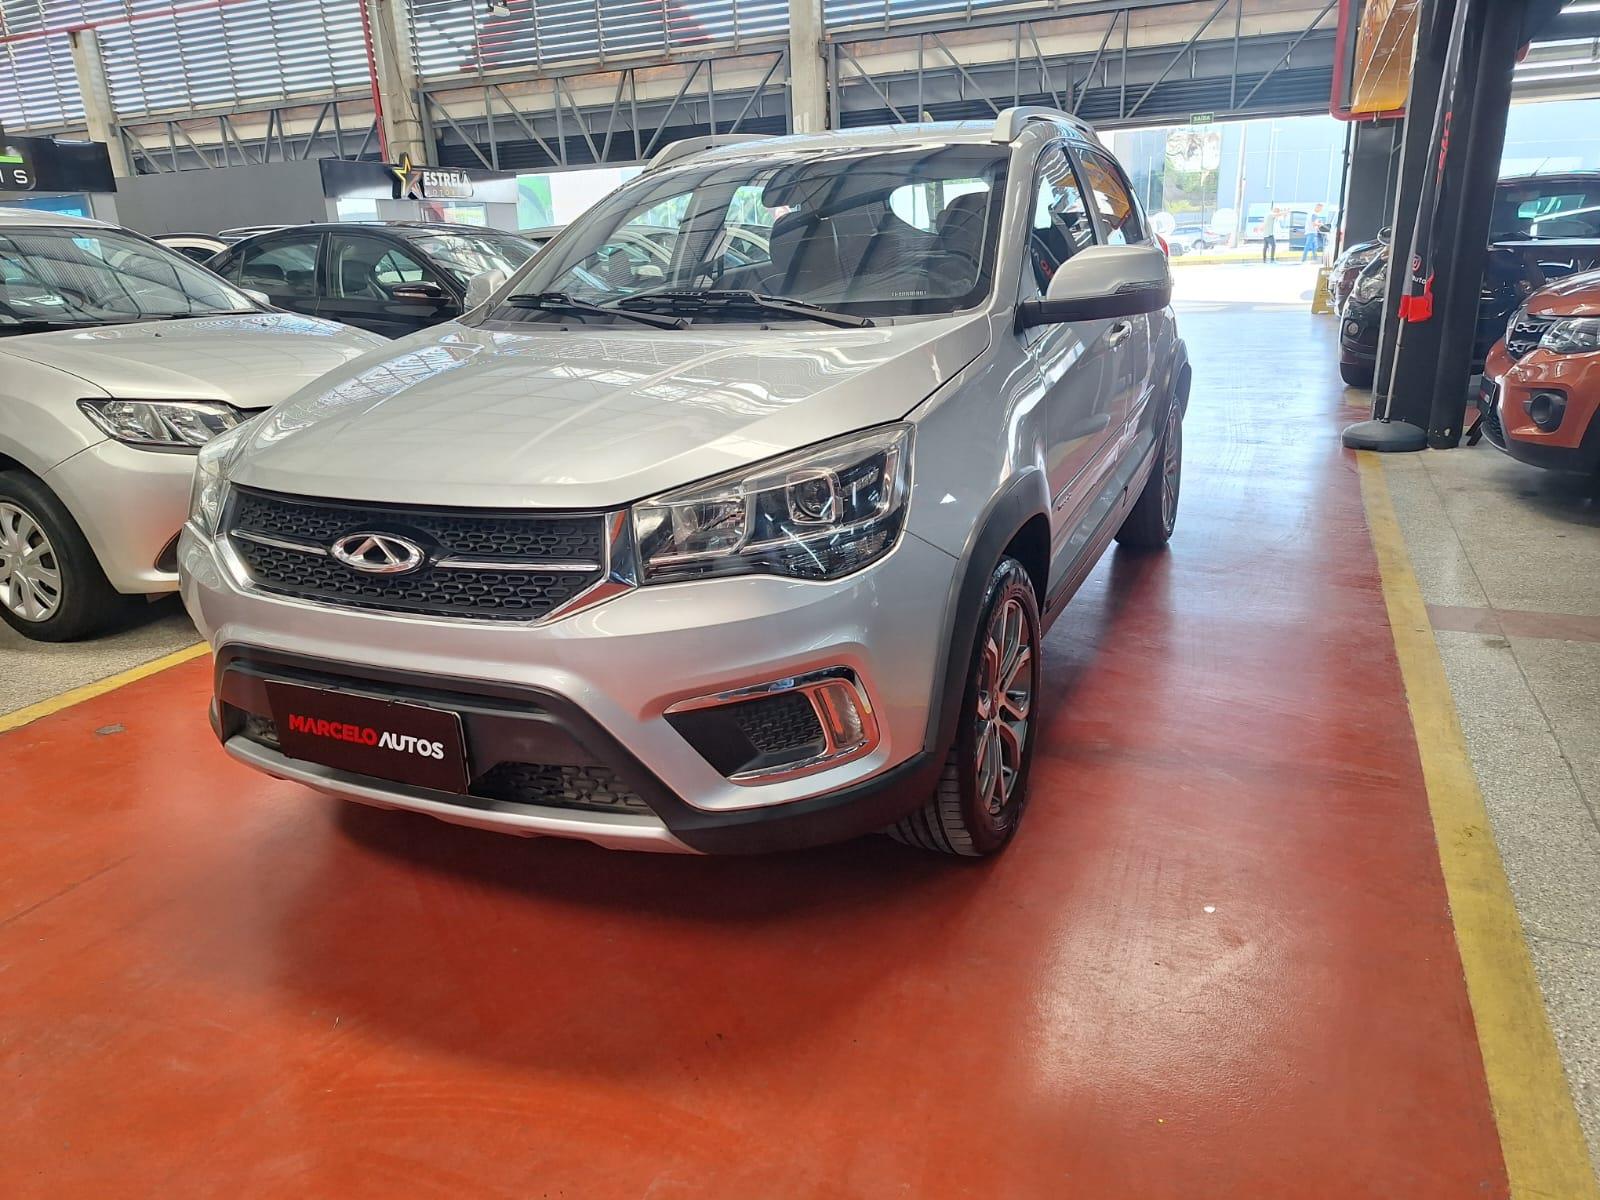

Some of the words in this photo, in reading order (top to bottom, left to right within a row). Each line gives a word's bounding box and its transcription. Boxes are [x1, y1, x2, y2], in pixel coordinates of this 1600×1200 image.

[0, 169, 28, 184] S
[423, 171, 471, 186] ESTRELA
[288, 713, 378, 746] MARCELO
[378, 731, 445, 760] AUTOS
